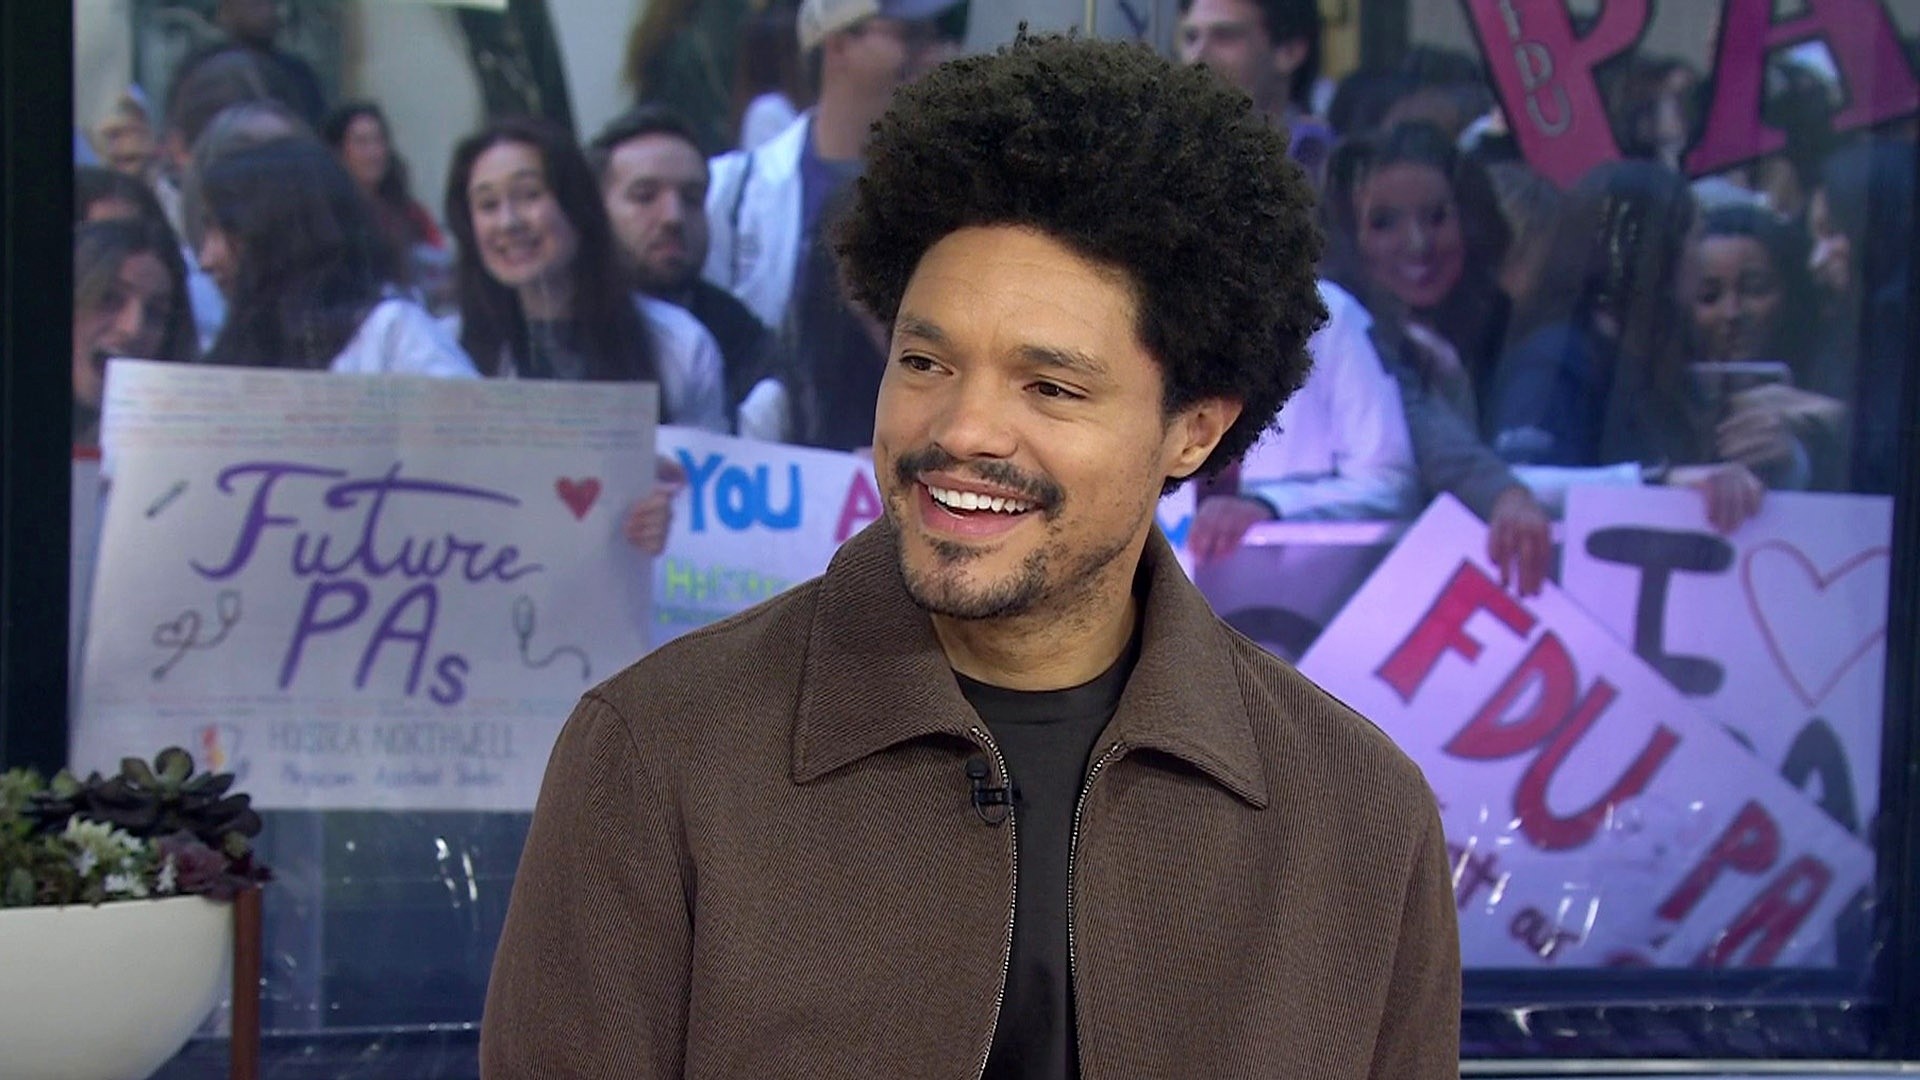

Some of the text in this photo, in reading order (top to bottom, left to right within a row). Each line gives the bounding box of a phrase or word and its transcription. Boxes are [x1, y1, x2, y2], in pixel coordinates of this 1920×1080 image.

[189, 461, 544, 581] Future
[675, 446, 803, 533] YOU
[1373, 557, 1682, 851] FDU
[1656, 799, 1836, 967] PA
